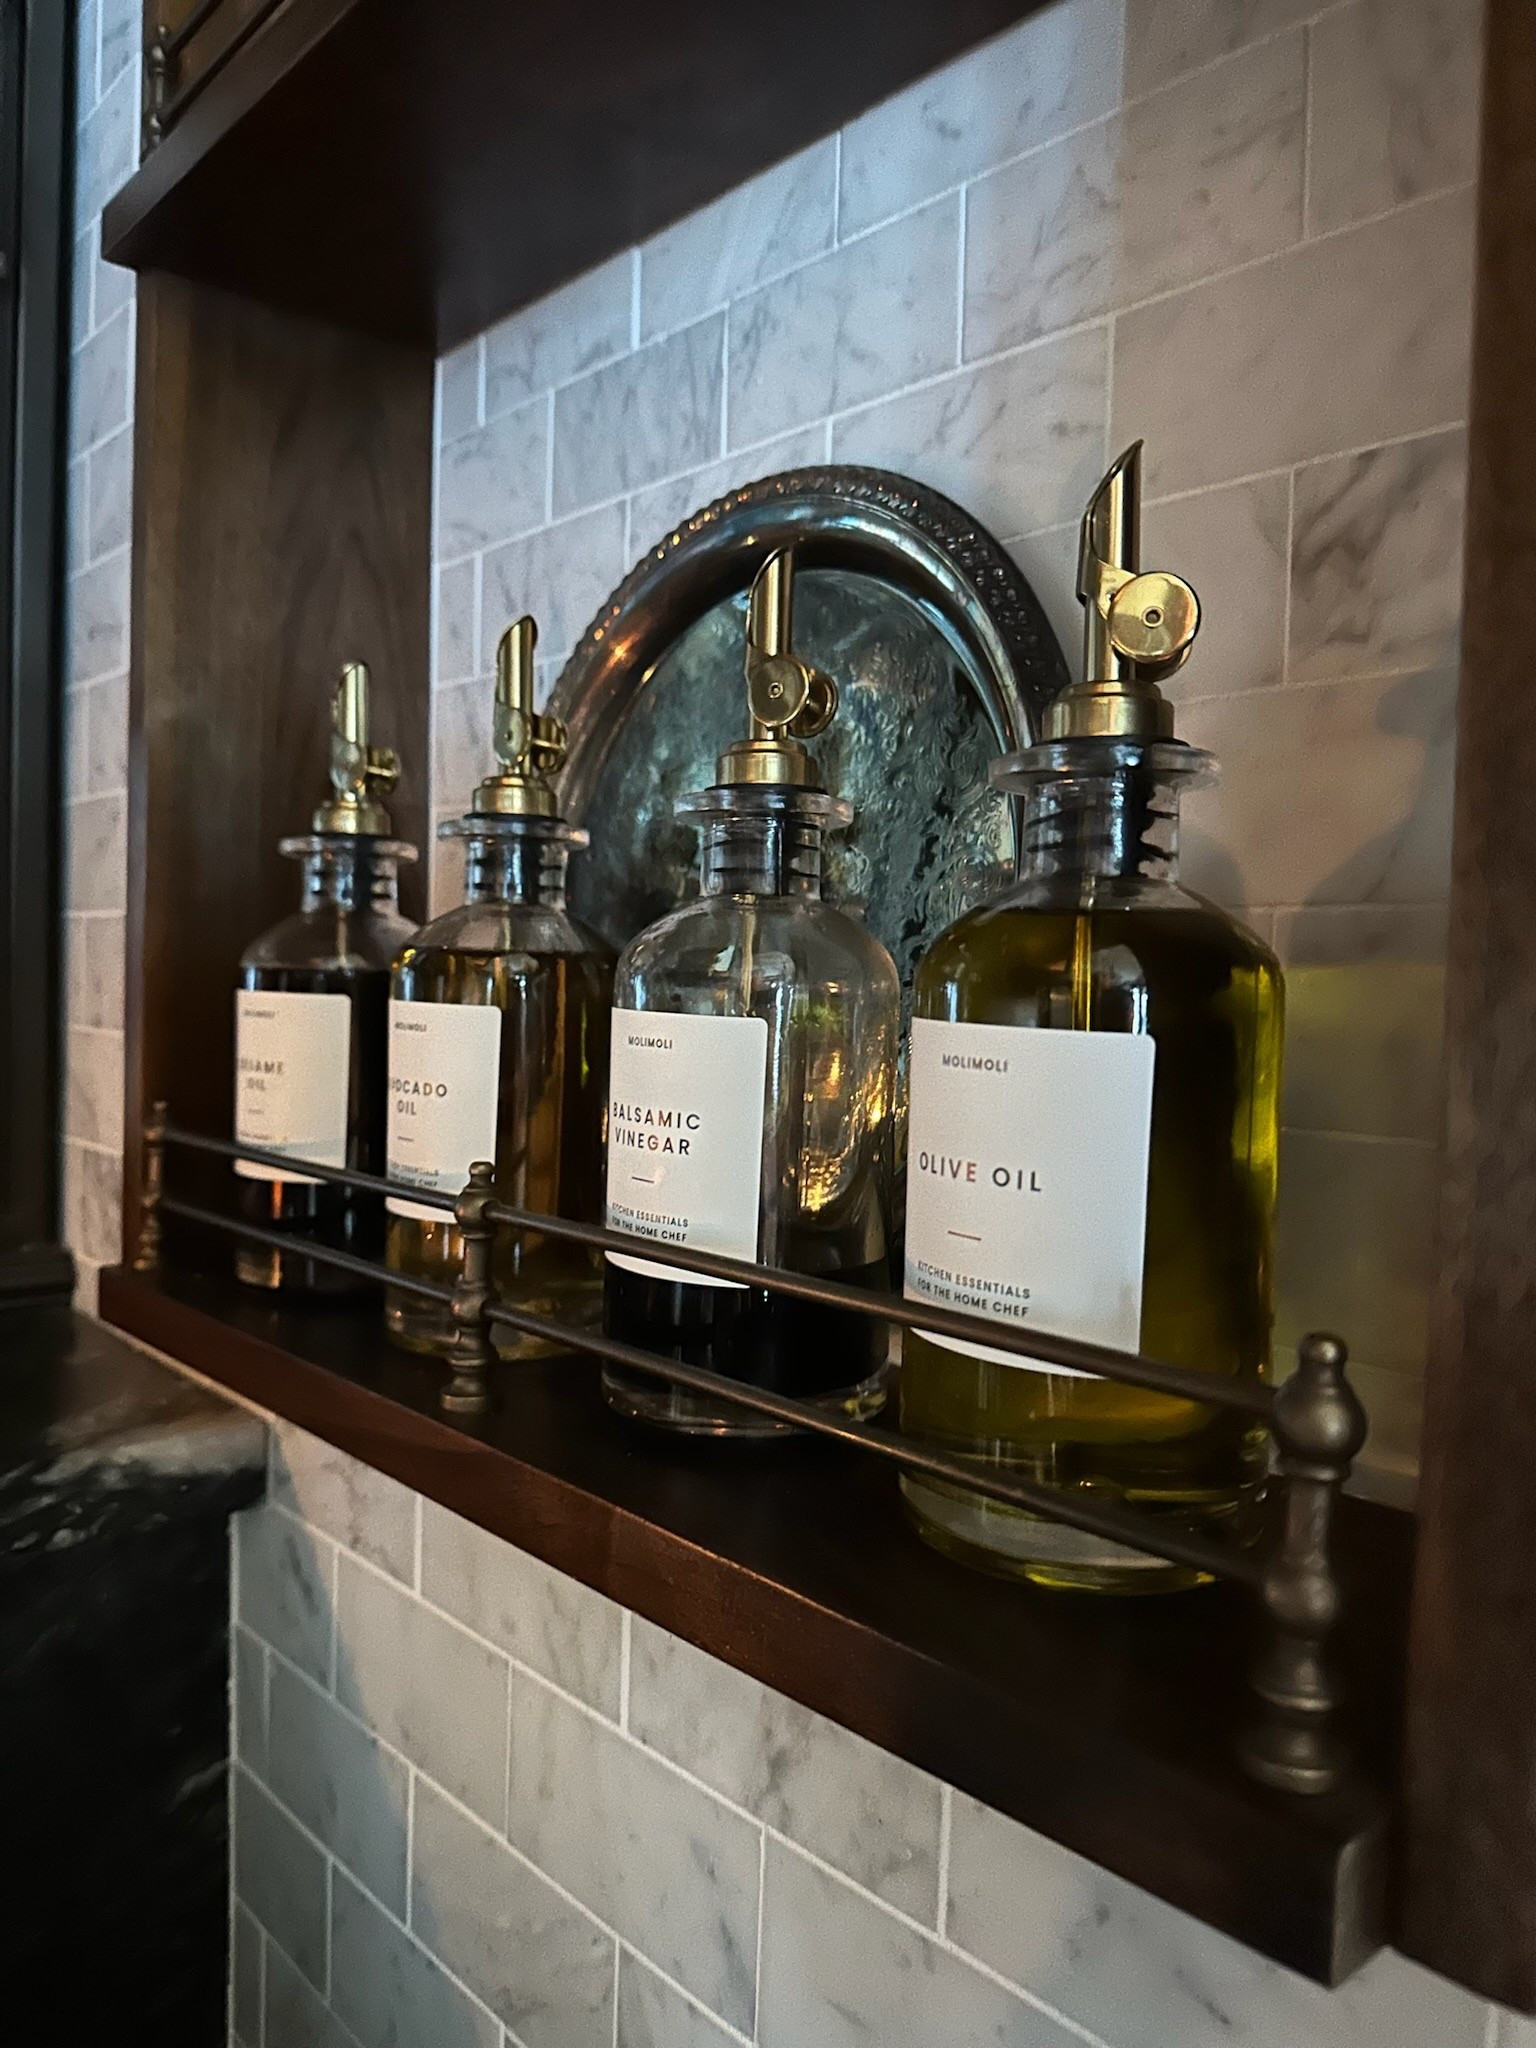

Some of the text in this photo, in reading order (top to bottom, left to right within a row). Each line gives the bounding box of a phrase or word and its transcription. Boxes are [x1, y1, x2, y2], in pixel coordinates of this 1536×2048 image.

[628, 1036, 673, 1049] MOLIMOLI
[942, 1053, 1009, 1073] MOLIMOLI
[397, 1100, 417, 1116] OIL
[613, 1101, 701, 1130] BALSAMIC
[615, 1126, 691, 1156] VINEGAR
[919, 1151, 1042, 1192] OLIVE OIL
[622, 1220, 634, 1232] THE
[635, 1226, 659, 1238] HOME
[661, 1230, 688, 1242] CHEF
[636, 1210, 690, 1228] ESSENTIALS
[918, 1260, 1031, 1300] KITCHEN ESSENTIALS
[917, 1278, 1030, 1318] FOR THE HOME CHEF
